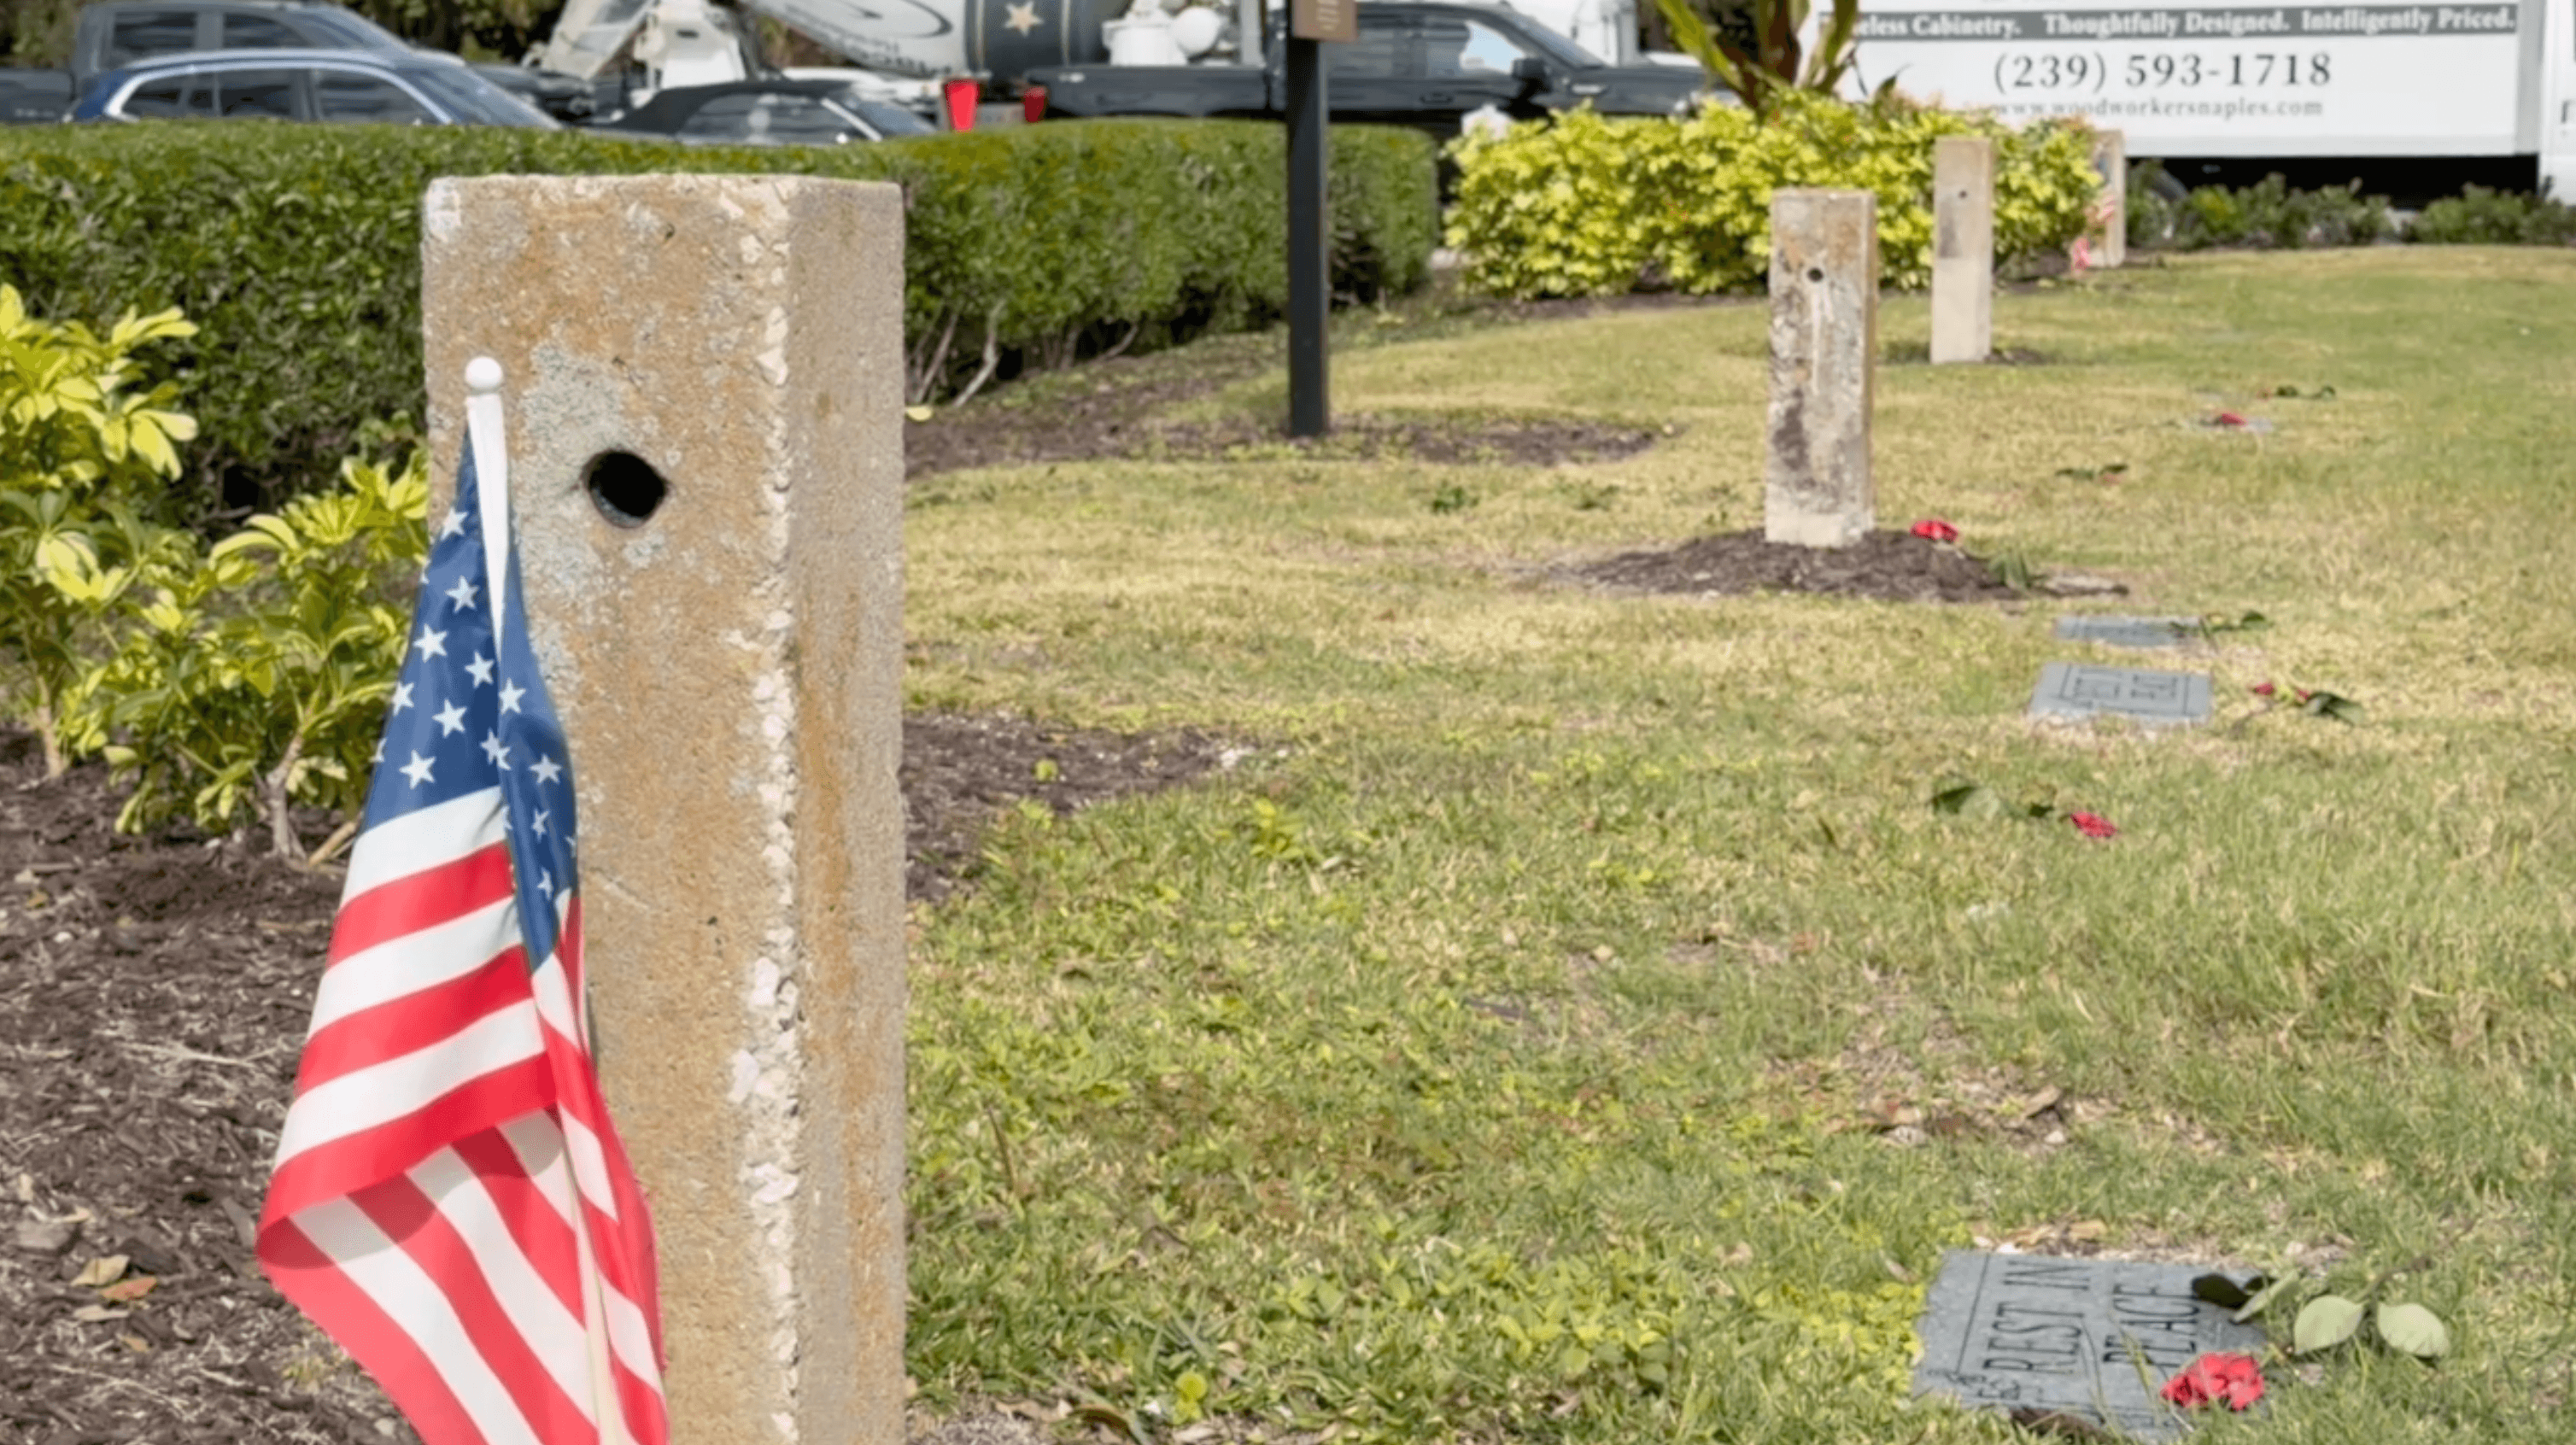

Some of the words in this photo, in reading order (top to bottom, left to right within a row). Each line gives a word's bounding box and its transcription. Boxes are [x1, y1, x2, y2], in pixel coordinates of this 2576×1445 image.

[1912, 13, 2023, 40] Cabinetry.
[2042, 11, 2178, 39] Thoughtfully
[2184, 9, 2291, 38] Designed.
[2301, 7, 2433, 35] Intelligently
[2438, 5, 2516, 29] Priced.
[1994, 51, 2106, 94] (239)
[2125, 52, 2332, 86] 593-1718
[2001, 1260, 2093, 1291] IN
[1982, 1302, 2085, 1375] REST
[2103, 1283, 2201, 1368] PEACE
